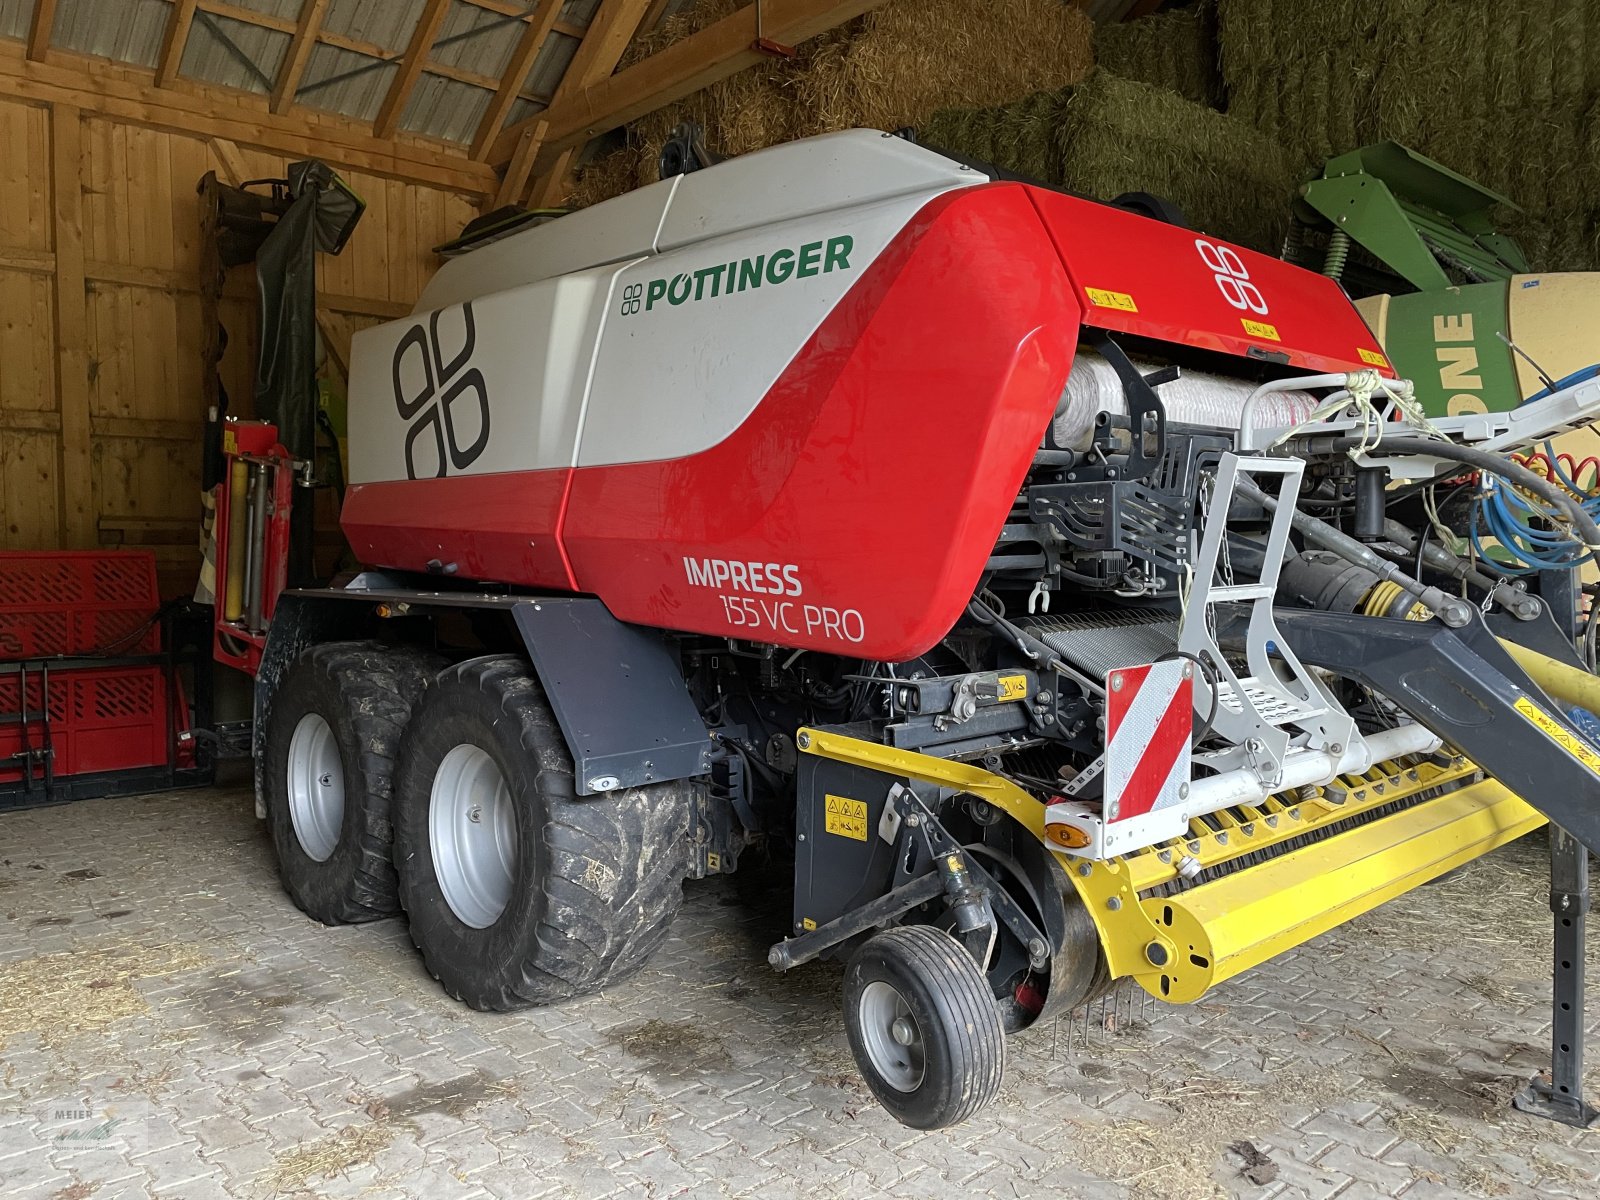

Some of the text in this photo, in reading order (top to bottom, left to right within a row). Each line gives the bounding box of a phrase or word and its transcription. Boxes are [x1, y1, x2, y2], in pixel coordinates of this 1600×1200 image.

[645, 234, 854, 311] PÖTTINGER
[682, 556, 803, 597] IMPRESS
[719, 595, 865, 643] 155 VC PRO
